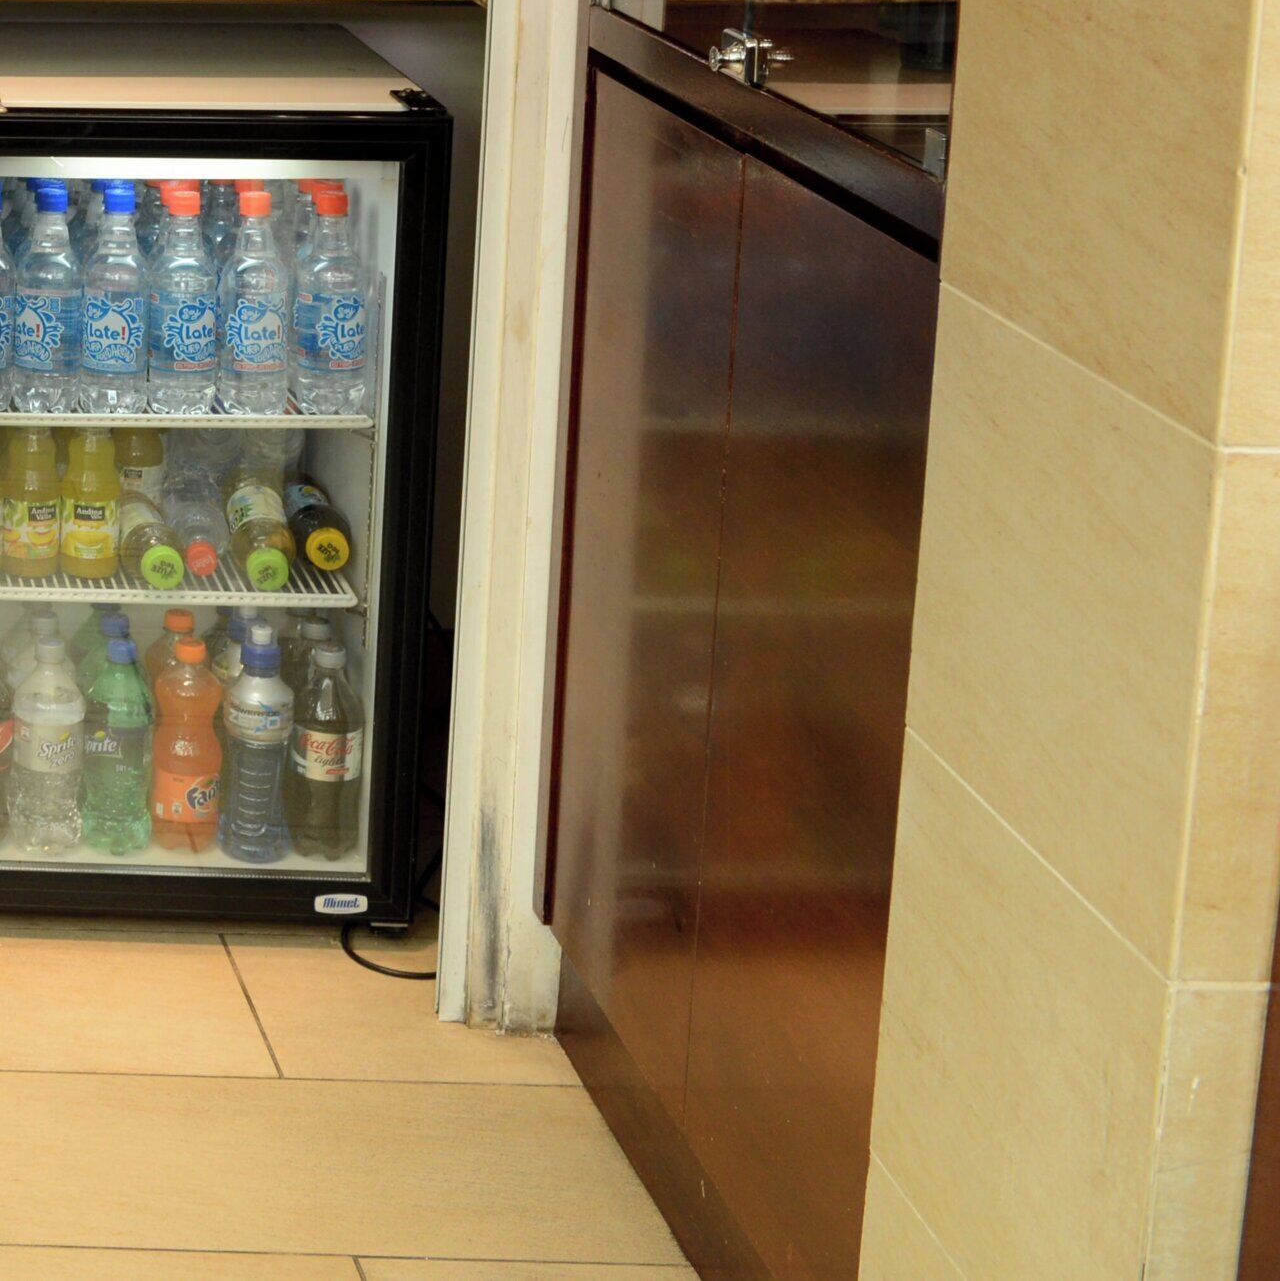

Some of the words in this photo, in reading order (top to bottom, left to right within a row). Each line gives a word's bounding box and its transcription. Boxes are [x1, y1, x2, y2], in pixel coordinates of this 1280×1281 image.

[39, 736, 78, 758] Sprite
[299, 732, 356, 756] Coca-Cola
[51, 751, 75, 768] zero
[322, 897, 360, 909] Mimet
